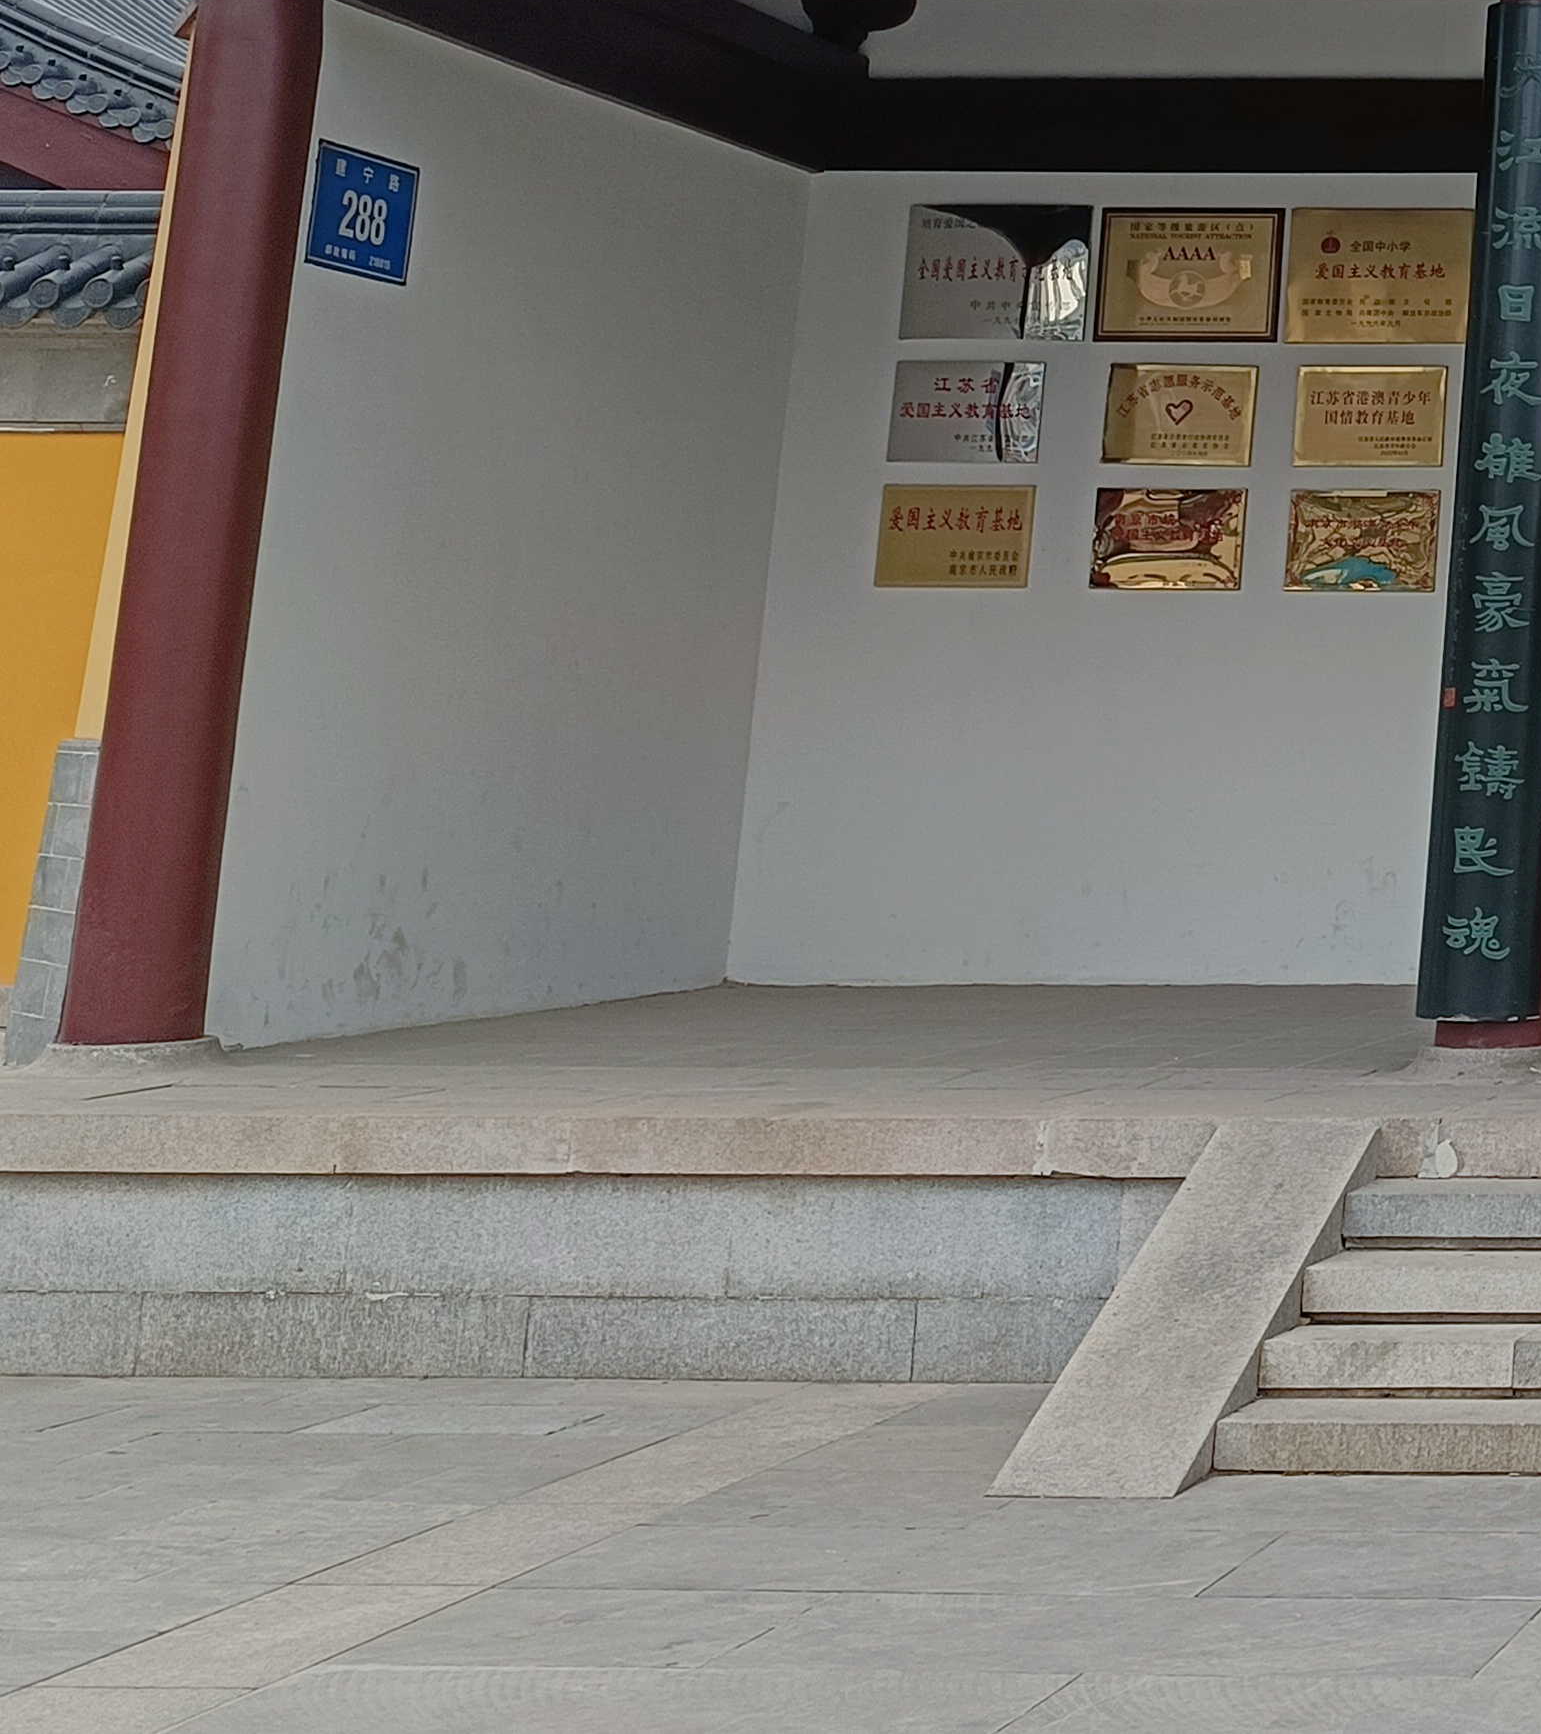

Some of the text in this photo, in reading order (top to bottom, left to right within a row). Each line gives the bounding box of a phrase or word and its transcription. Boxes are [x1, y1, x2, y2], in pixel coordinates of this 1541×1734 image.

[338, 189, 388, 246] 288
[1163, 246, 1215, 261] AAAA
[1350, 240, 1411, 253] 全国中小学
[1315, 262, 1446, 280] 爱国主义教育基地
[933, 377, 1000, 394] 江苏省
[1116, 374, 1242, 421] 江苏省志愿服务示范基地
[1310, 390, 1431, 406] 江苏省港澳青少年
[1324, 410, 1415, 425] 国情教育基地
[889, 506, 1022, 533] 爱国主义教育基地
